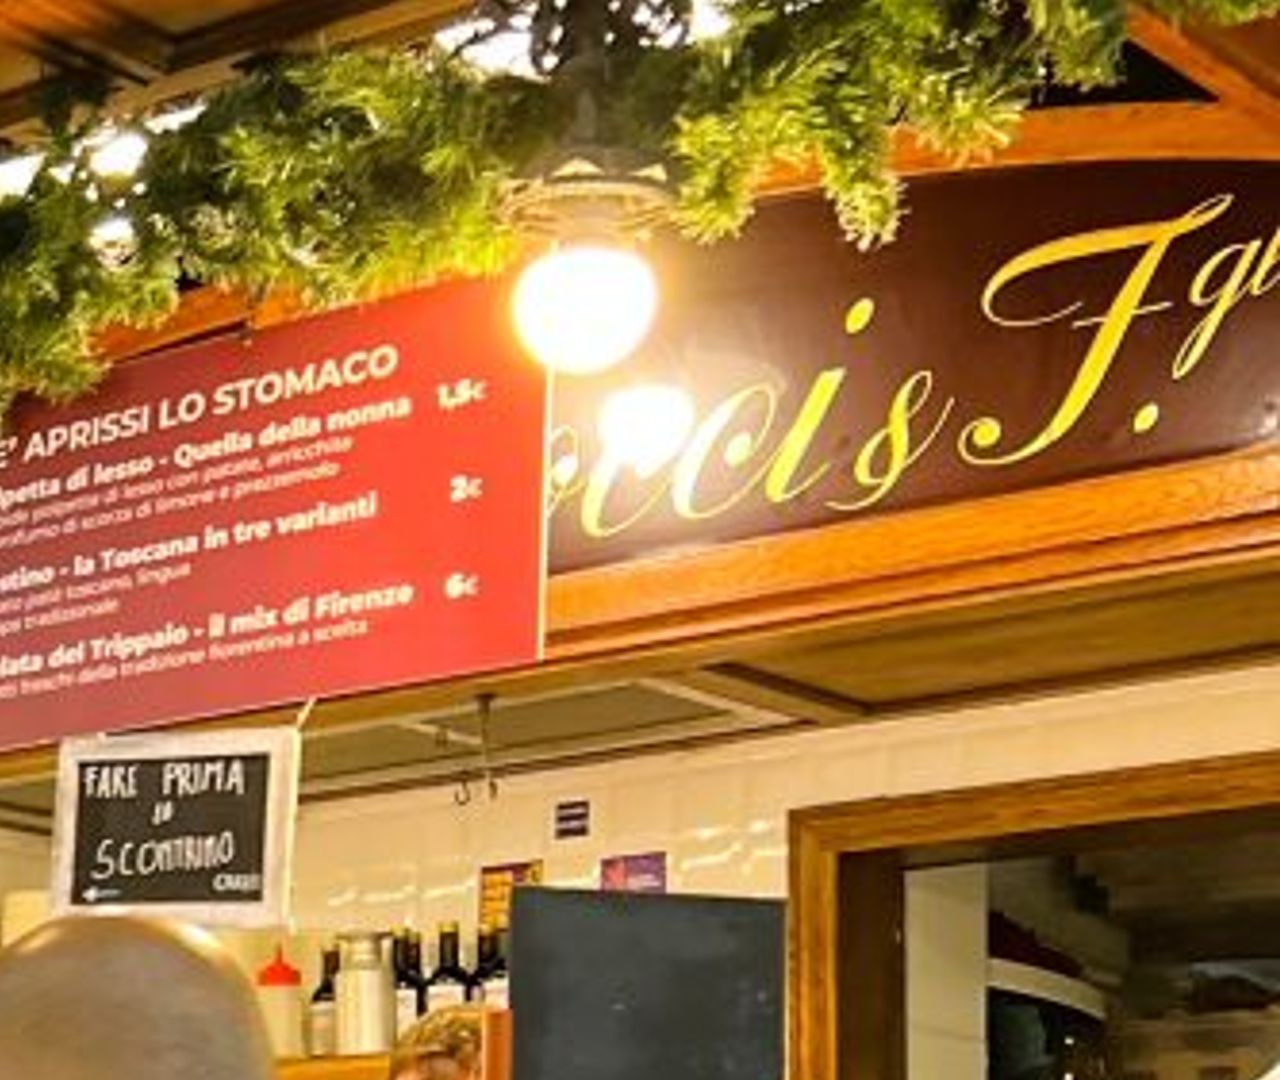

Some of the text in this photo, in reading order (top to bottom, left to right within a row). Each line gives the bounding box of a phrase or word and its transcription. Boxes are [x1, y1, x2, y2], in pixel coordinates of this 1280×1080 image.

[22, 403, 150, 462] APRISSI
[158, 391, 206, 429] LO
[212, 343, 399, 415] STOMACO
[65, 465, 89, 491] di
[93, 455, 155, 484] lesso
[173, 431, 253, 468] Quella
[258, 415, 321, 446] della
[326, 395, 412, 431] nonna
[826, 370, 955, 511] &
[73, 554, 95, 576] la
[99, 535, 199, 571] Toscana
[203, 524, 229, 550] in
[232, 519, 272, 544] tre
[275, 489, 378, 535] varianti
[47, 640, 85, 668] del
[89, 621, 190, 660] Trippaio
[229, 604, 278, 634] mix
[281, 596, 310, 625] di
[314, 583, 415, 619] Firenze
[83, 760, 245, 799] FARE PRIMA
